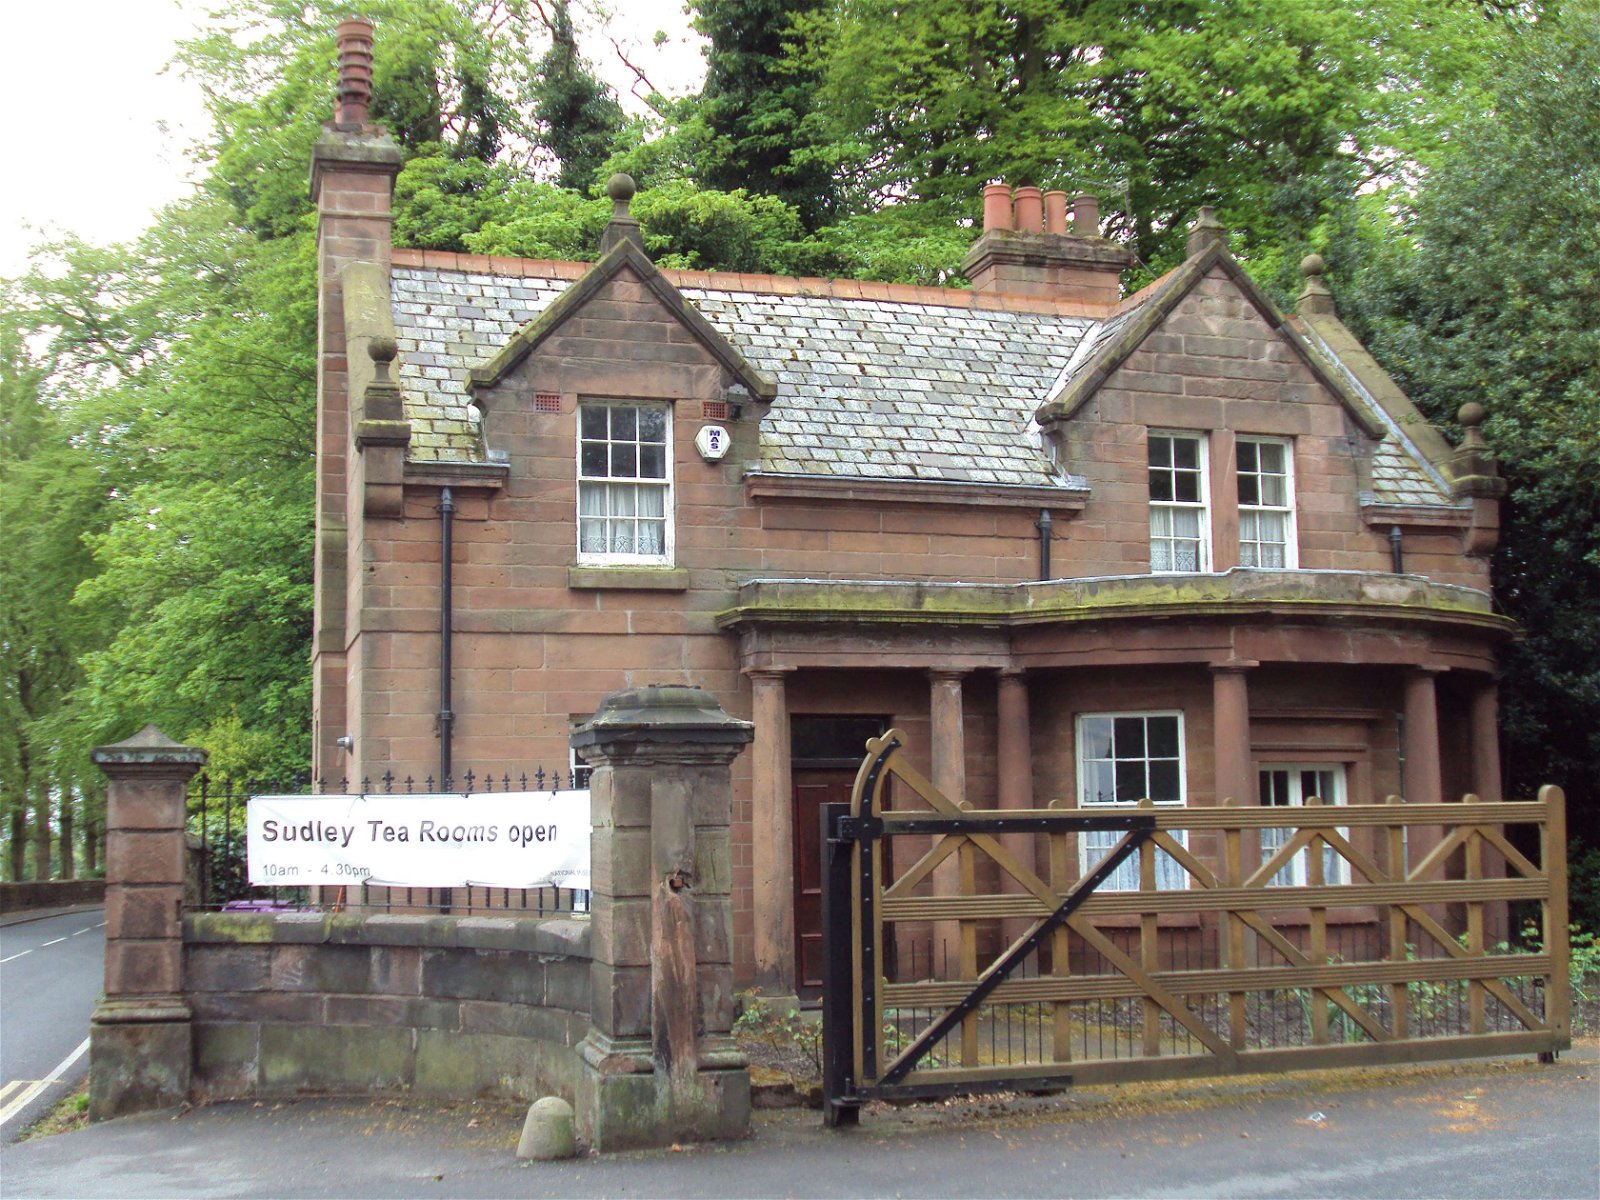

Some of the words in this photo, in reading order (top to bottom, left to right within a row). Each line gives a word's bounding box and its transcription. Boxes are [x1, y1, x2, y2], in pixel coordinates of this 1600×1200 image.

[709, 430, 721, 449] MAS
[262, 820, 355, 848] Sudley
[367, 820, 410, 843] Tea
[419, 820, 499, 843] Rooms
[508, 822, 558, 848] open
[263, 864, 299, 876] 10am
[320, 863, 371, 877] 4.30pm
